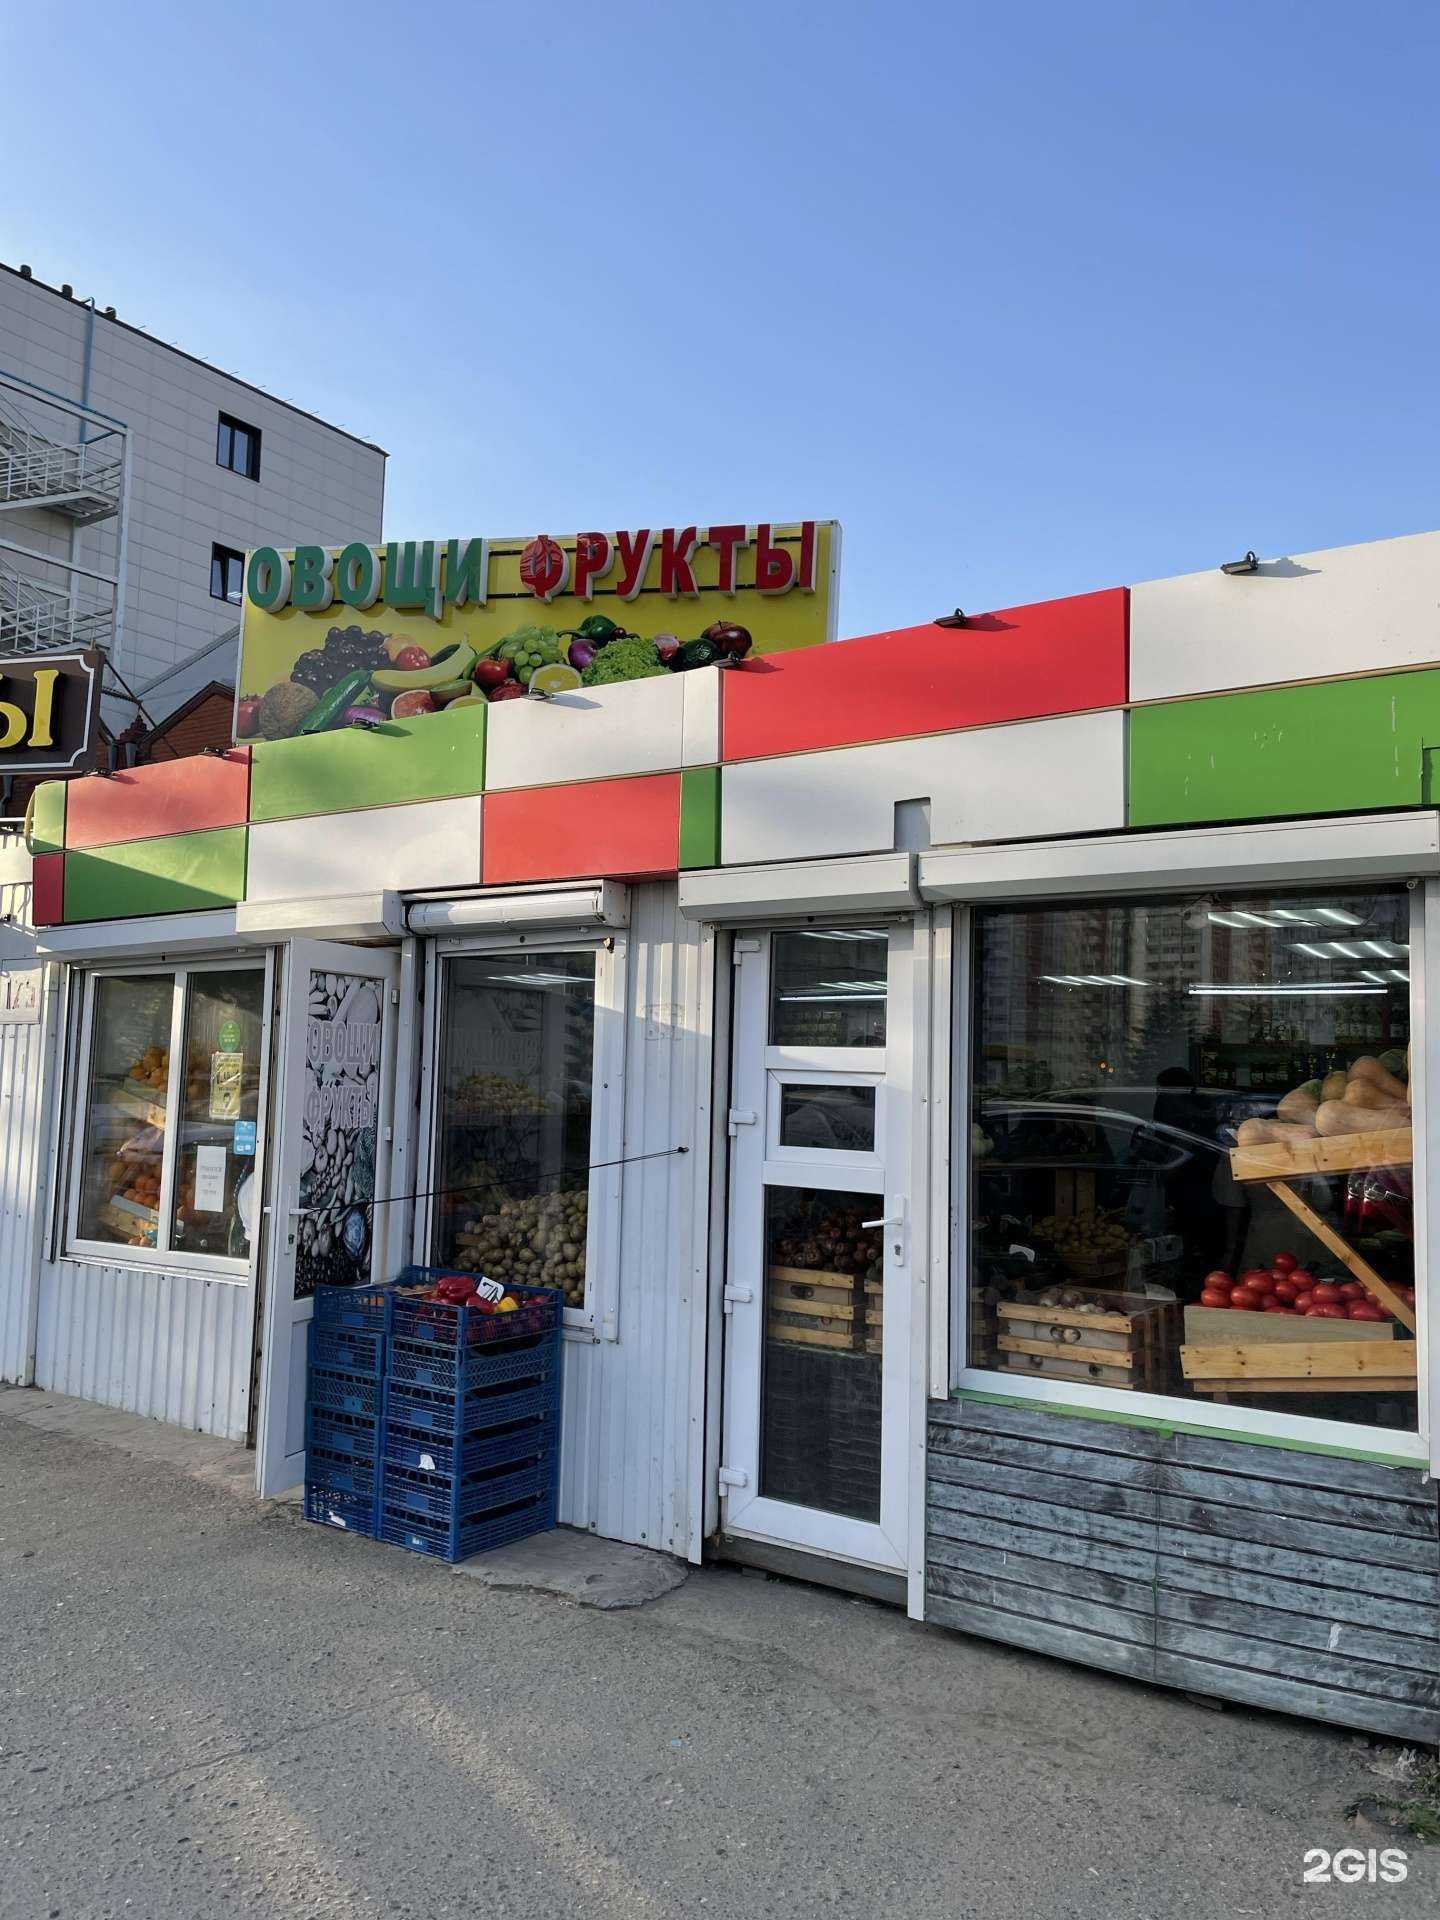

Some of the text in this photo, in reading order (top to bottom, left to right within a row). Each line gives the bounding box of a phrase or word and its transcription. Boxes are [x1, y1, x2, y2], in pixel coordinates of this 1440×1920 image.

[247, 520, 816, 621] ОВОЩИ ФРУКТЫ
[308, 1020, 380, 1072] ОВОЩИ
[305, 1086, 376, 1132] ФРУКТЫ
